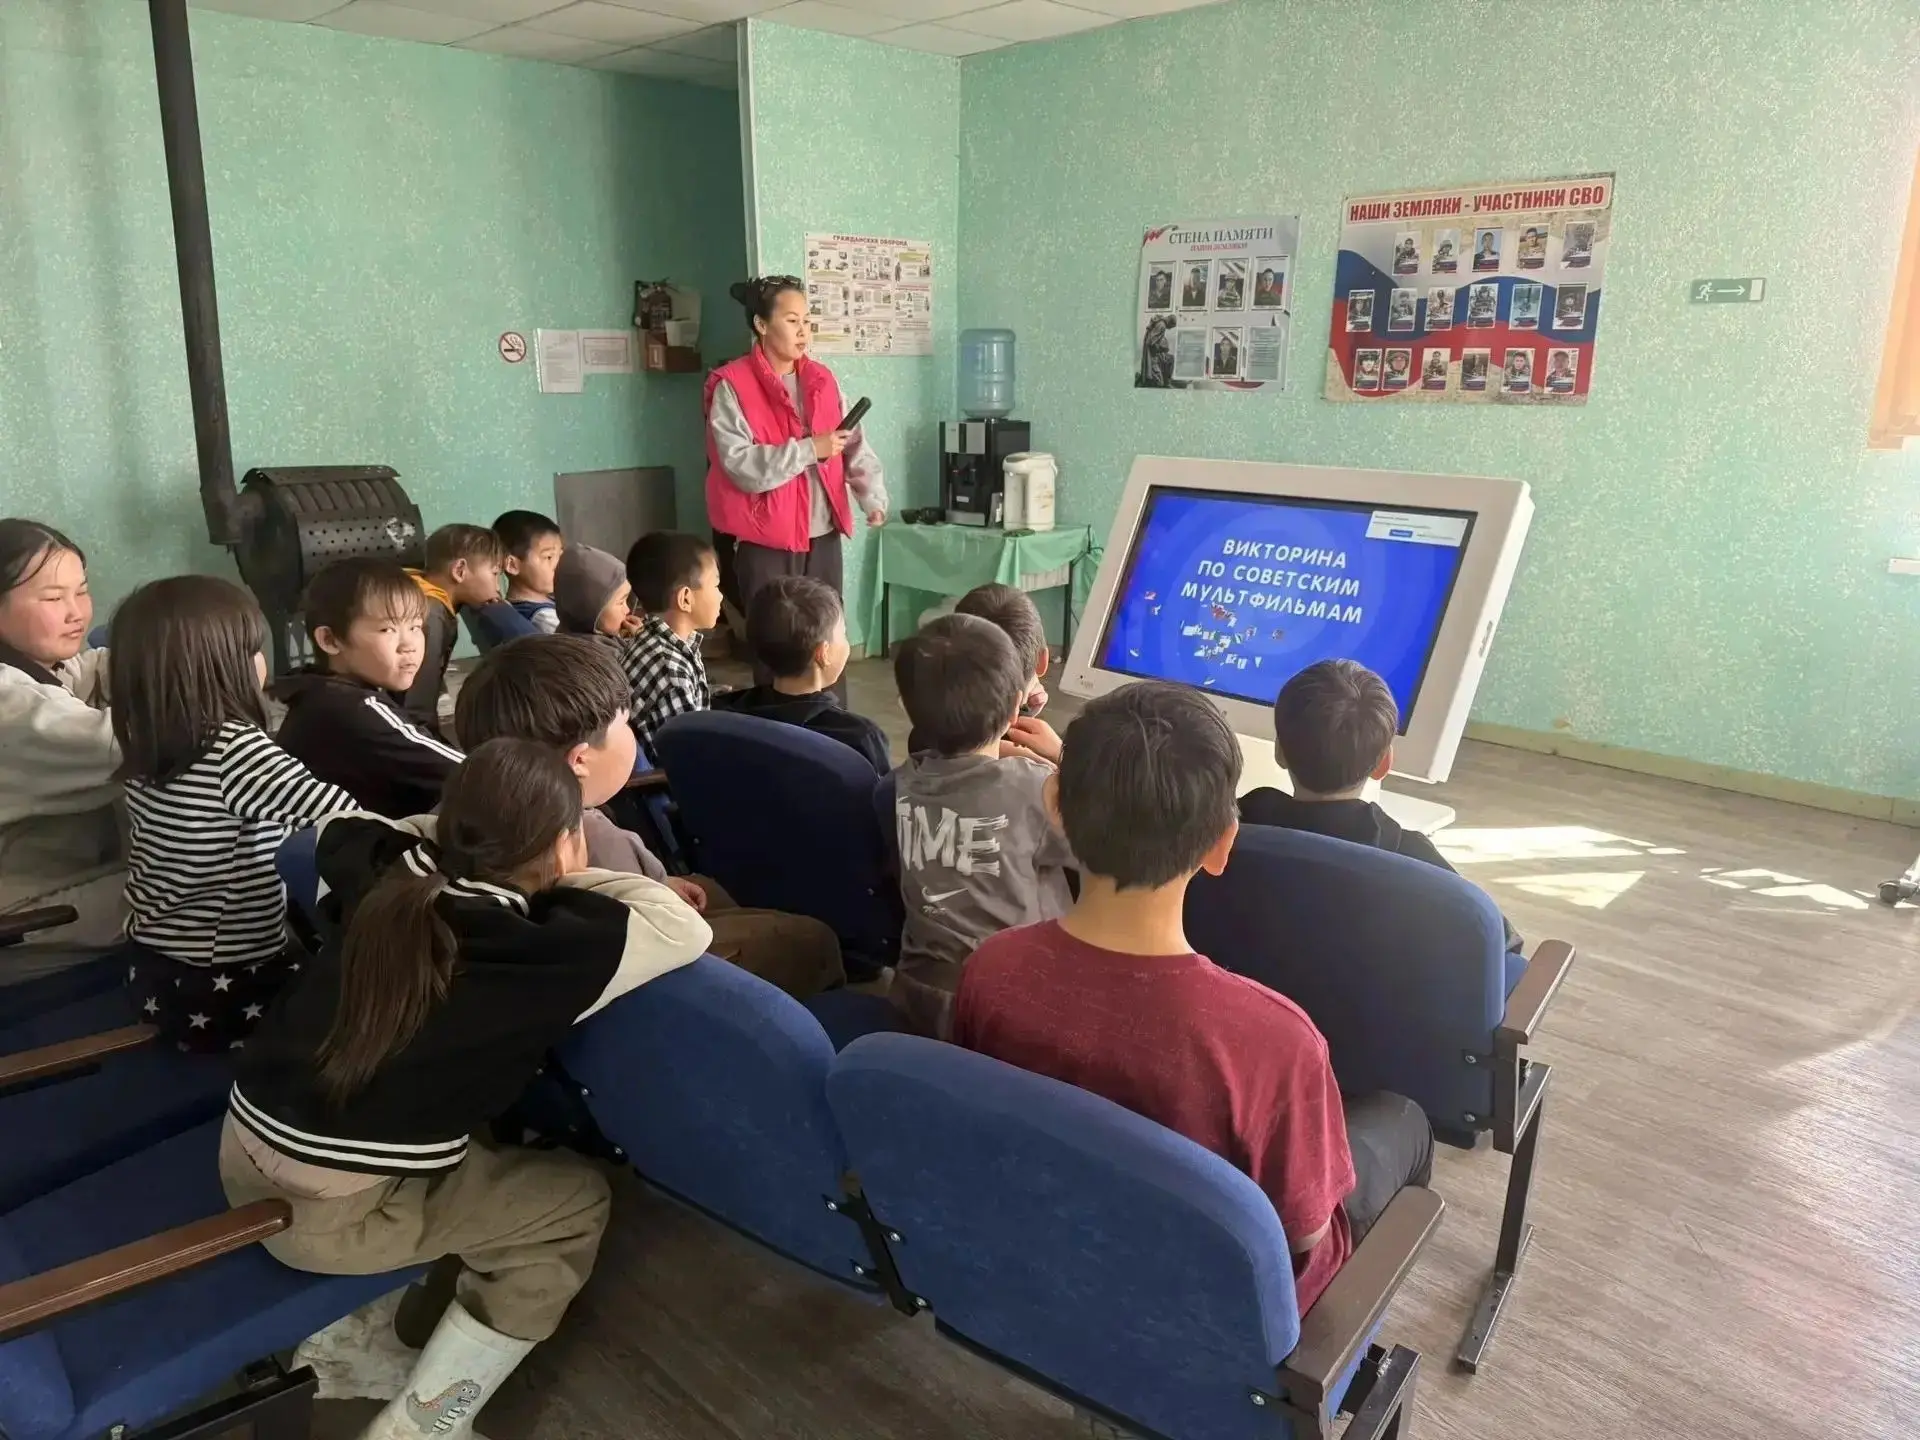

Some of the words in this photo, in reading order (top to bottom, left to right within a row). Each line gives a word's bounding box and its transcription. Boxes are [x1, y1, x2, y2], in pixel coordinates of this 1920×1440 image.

[1350, 203, 1390, 221] НАШИ
[1393, 196, 1462, 218] ЗЕМЛЯКИ
[1473, 189, 1566, 213] УЧАСТНИКИ
[1569, 186, 1605, 206] СВО
[1169, 231, 1211, 245] СТЕНА
[1214, 227, 1274, 242] ПАМЯТИ
[1223, 539, 1347, 569] ВИКТОРИНА
[1198, 560, 1225, 577] ПО
[1233, 565, 1360, 597] СОВЕТСКИМ
[1180, 582, 1363, 624] МУЛЬТФИЛЬМАМ
